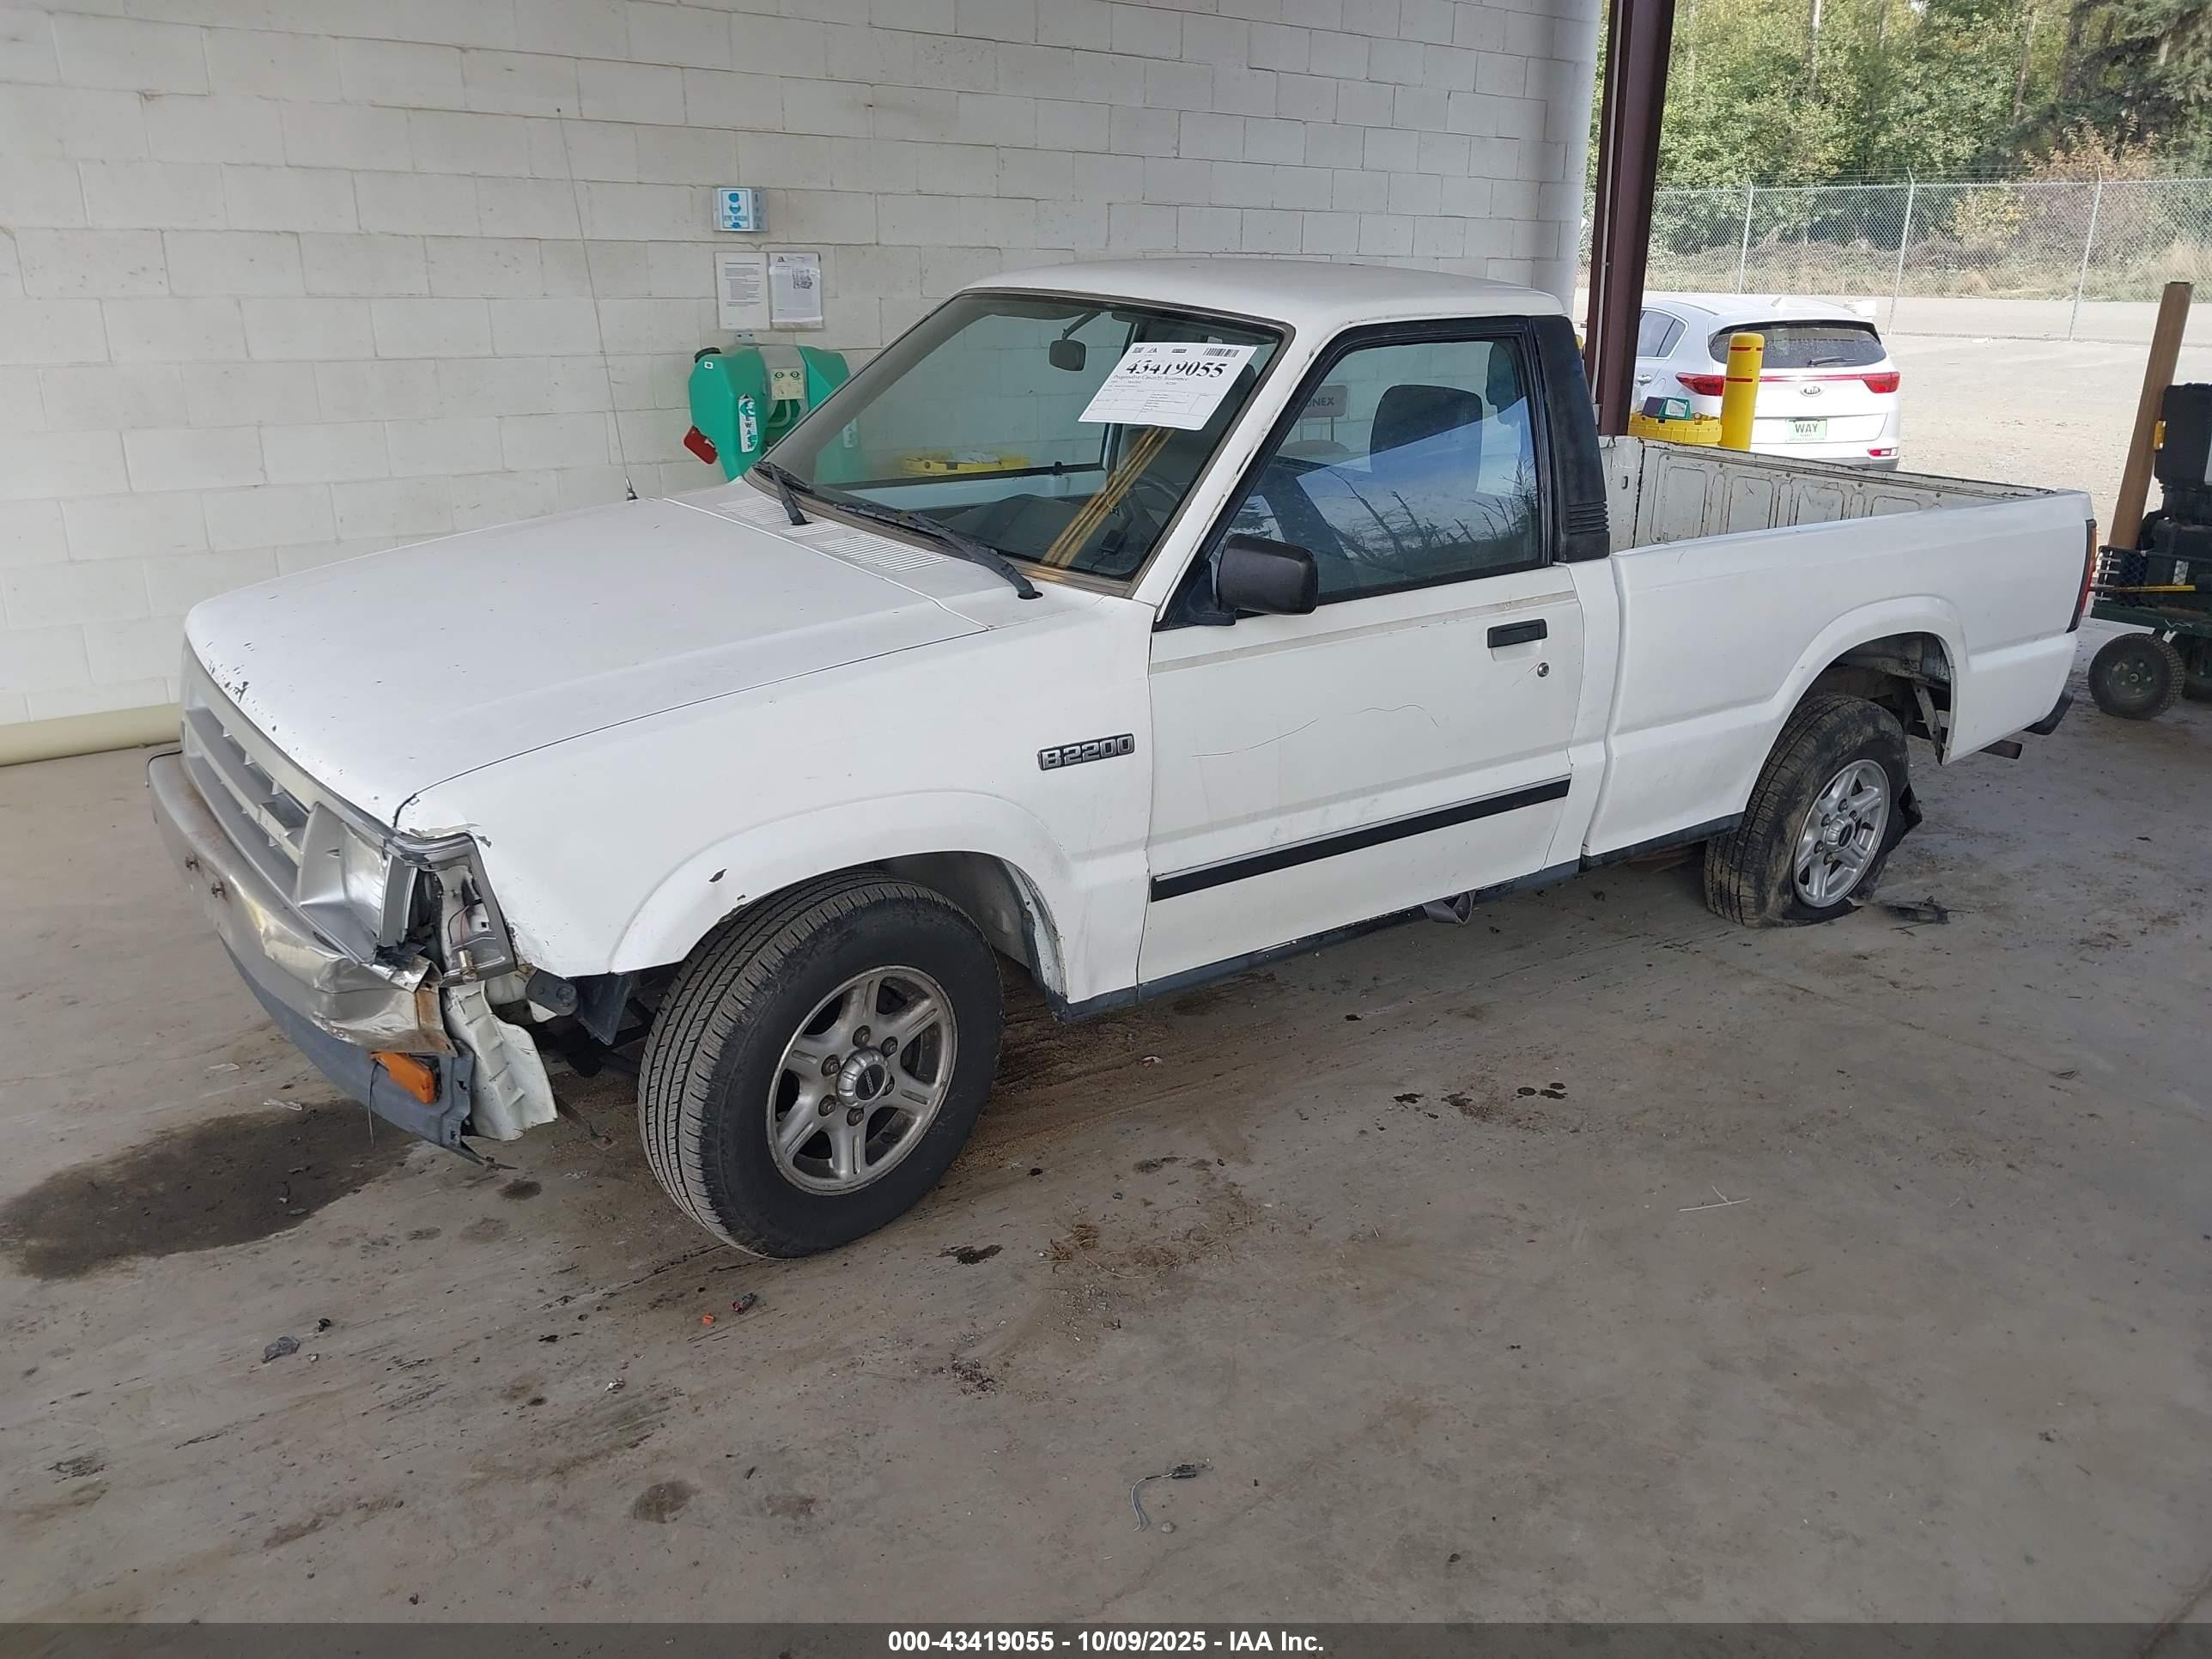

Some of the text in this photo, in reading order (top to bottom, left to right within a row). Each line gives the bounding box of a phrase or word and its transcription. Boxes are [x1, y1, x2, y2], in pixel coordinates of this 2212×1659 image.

[1126, 359, 1229, 378] 43419055
[1795, 423, 1818, 433] WAY
[1042, 735, 1133, 769] B2200
